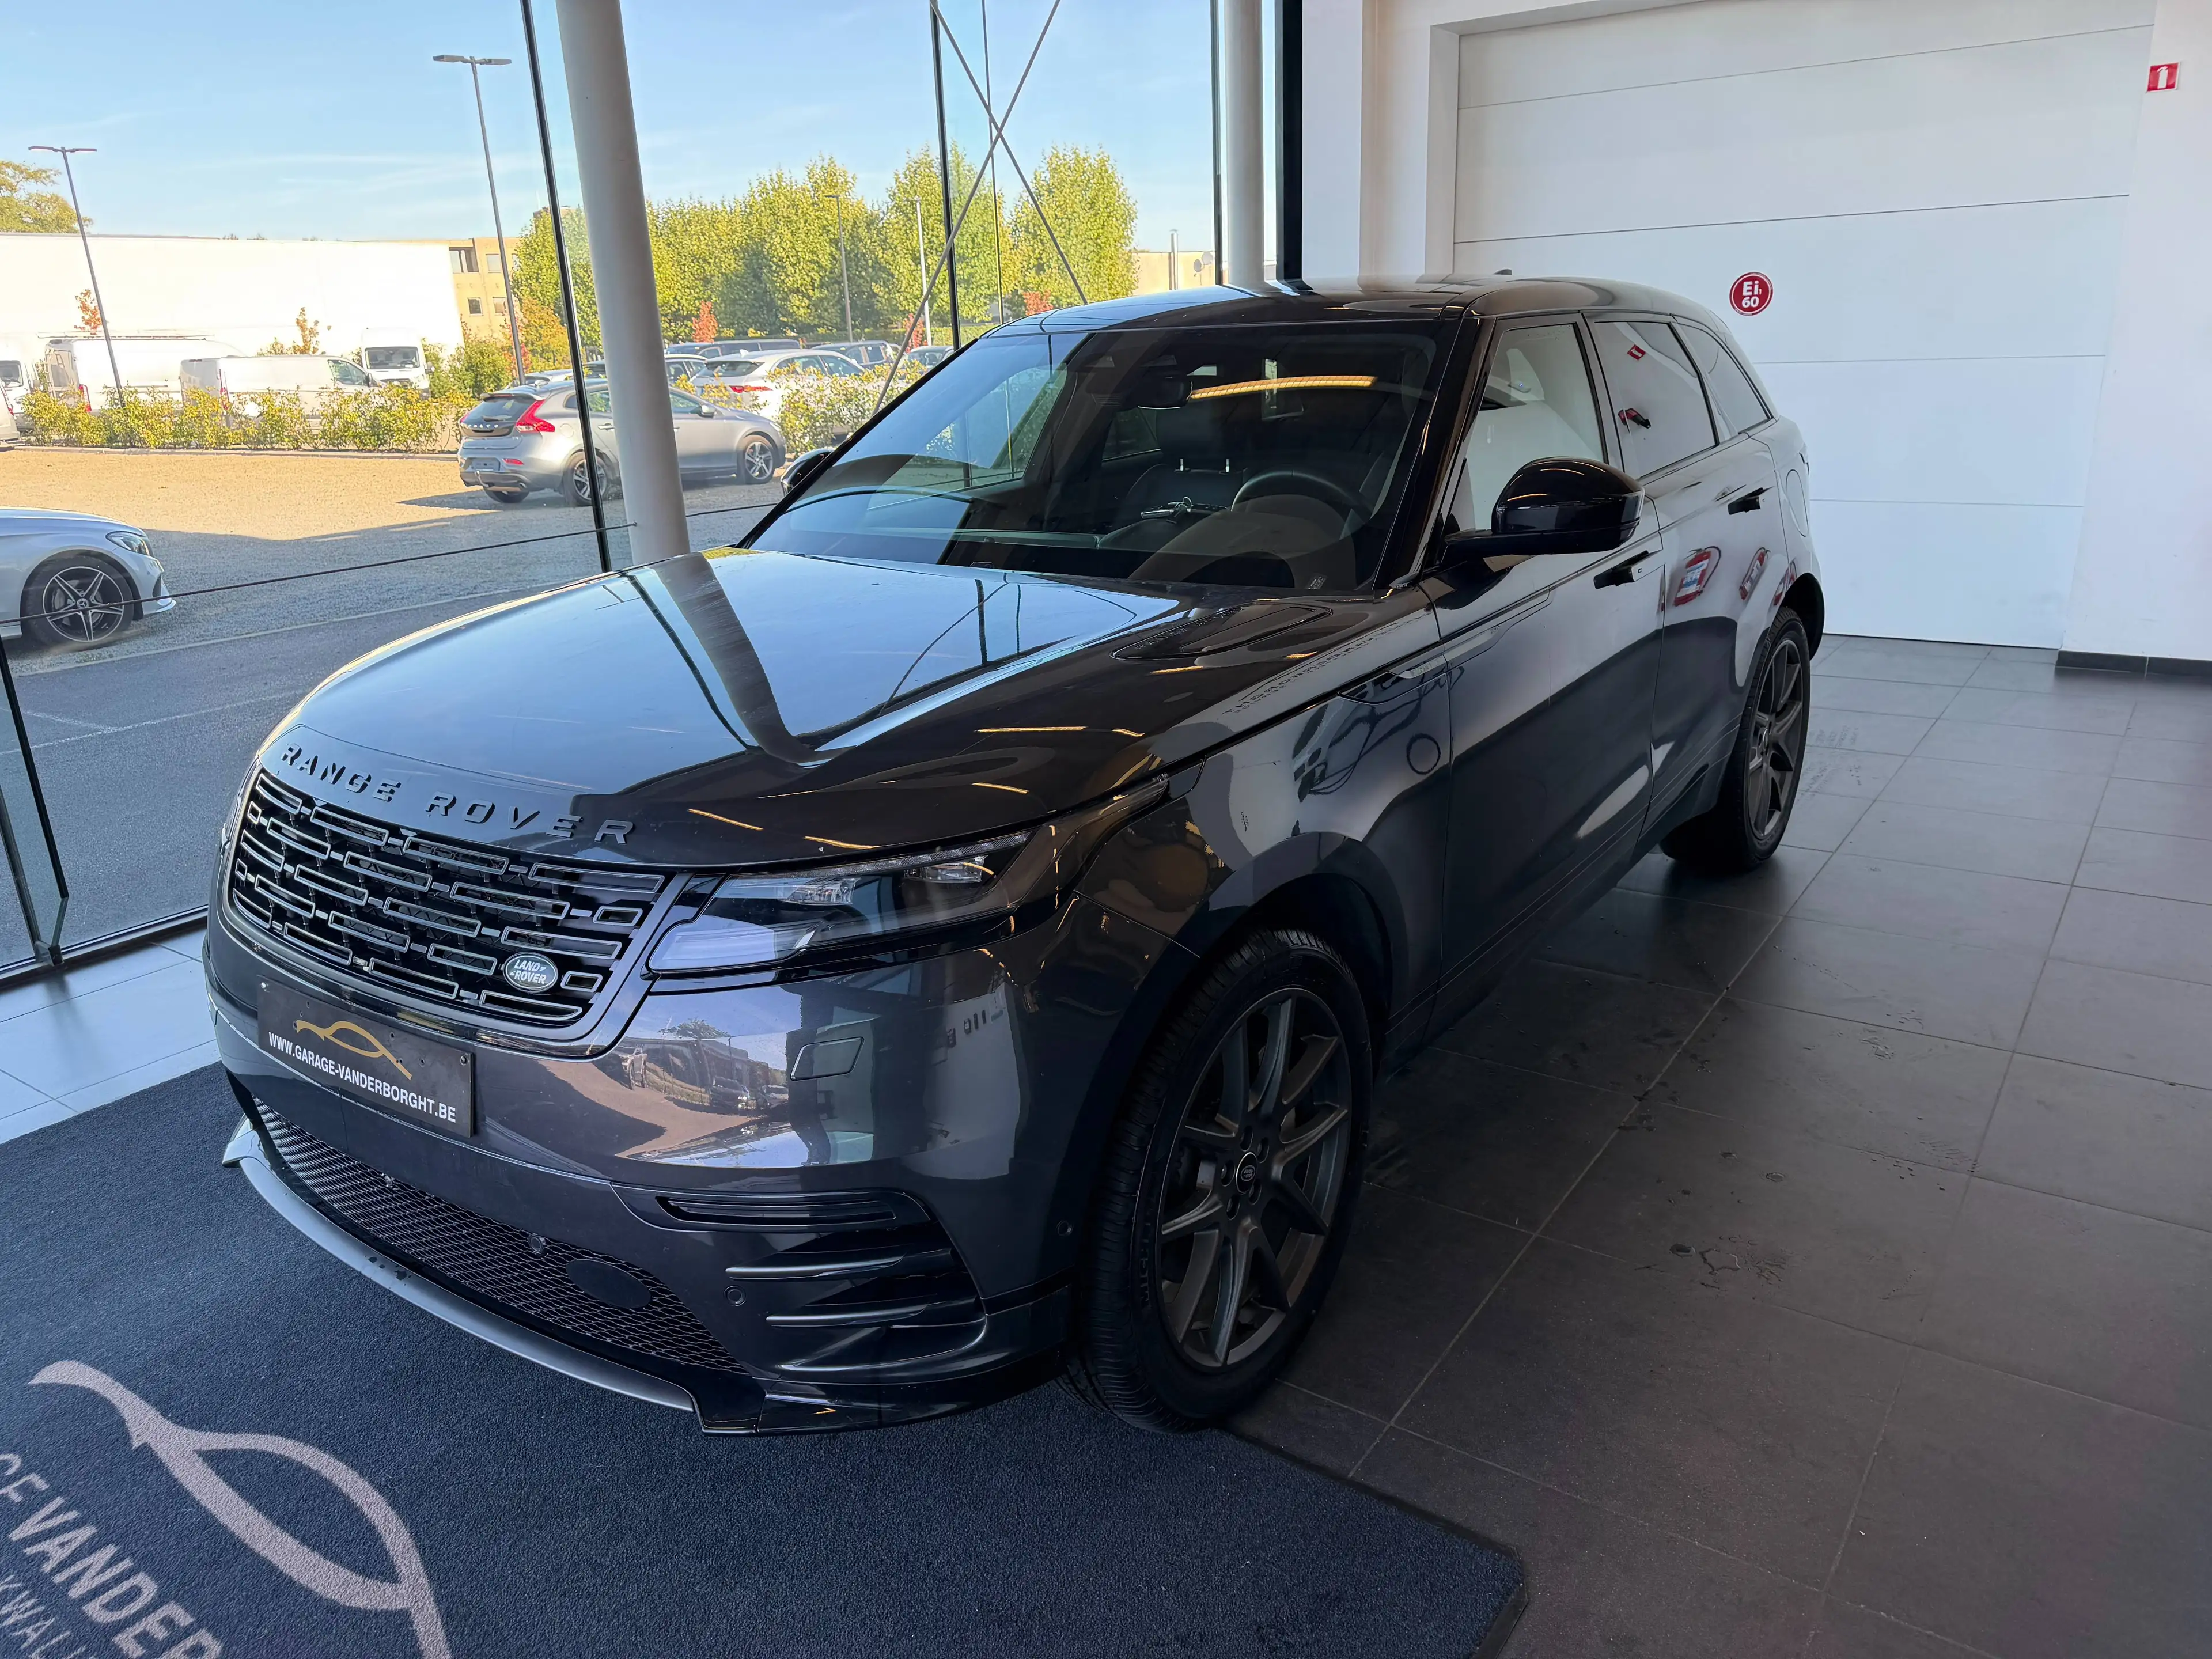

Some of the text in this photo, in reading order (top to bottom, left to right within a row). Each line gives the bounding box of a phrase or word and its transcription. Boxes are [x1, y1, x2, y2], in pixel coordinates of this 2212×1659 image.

[1741, 296, 1759, 308] 60
[281, 743, 635, 845] RANGE ROVER
[514, 959, 541, 972] LAND
[514, 970, 547, 984] ROVER
[268, 1032, 456, 1123] WWW.GARAGE-VANDERBORGHT.BE
